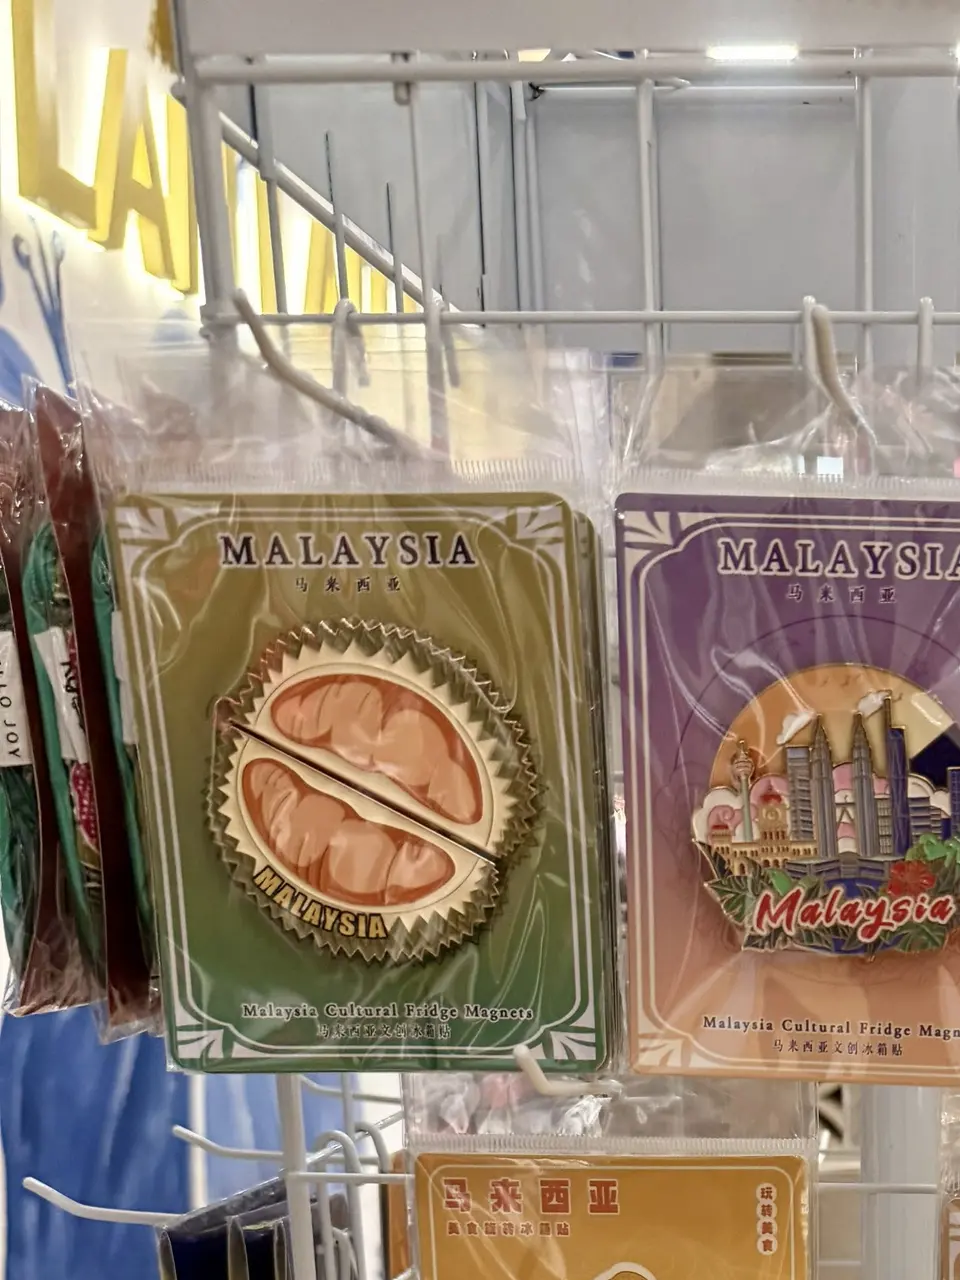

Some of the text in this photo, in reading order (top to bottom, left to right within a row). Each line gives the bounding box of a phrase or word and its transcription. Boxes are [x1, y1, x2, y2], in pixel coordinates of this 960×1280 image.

[218, 533, 477, 567] MALAYSIA
[295, 576, 401, 593] 马来西亚
[787, 583, 897, 604] 马来西亚
[3, 719, 22, 759] JOY
[253, 865, 389, 940] MALAYSIA
[754, 887, 955, 943] Malaysia
[241, 1002, 534, 1022] Malaysia Cultural Fridge Magnets
[317, 1023, 453, 1040] 马来西亚文创冰箱贴
[702, 1015, 774, 1034] Malaysia
[781, 1019, 851, 1035] Cultural
[859, 1022, 912, 1038] Fridge
[772, 1038, 904, 1057] 马来西亚文创冰箱贴
[442, 1177, 620, 1216] 马来西亚
[759, 1185, 775, 1254] 玩转美食
